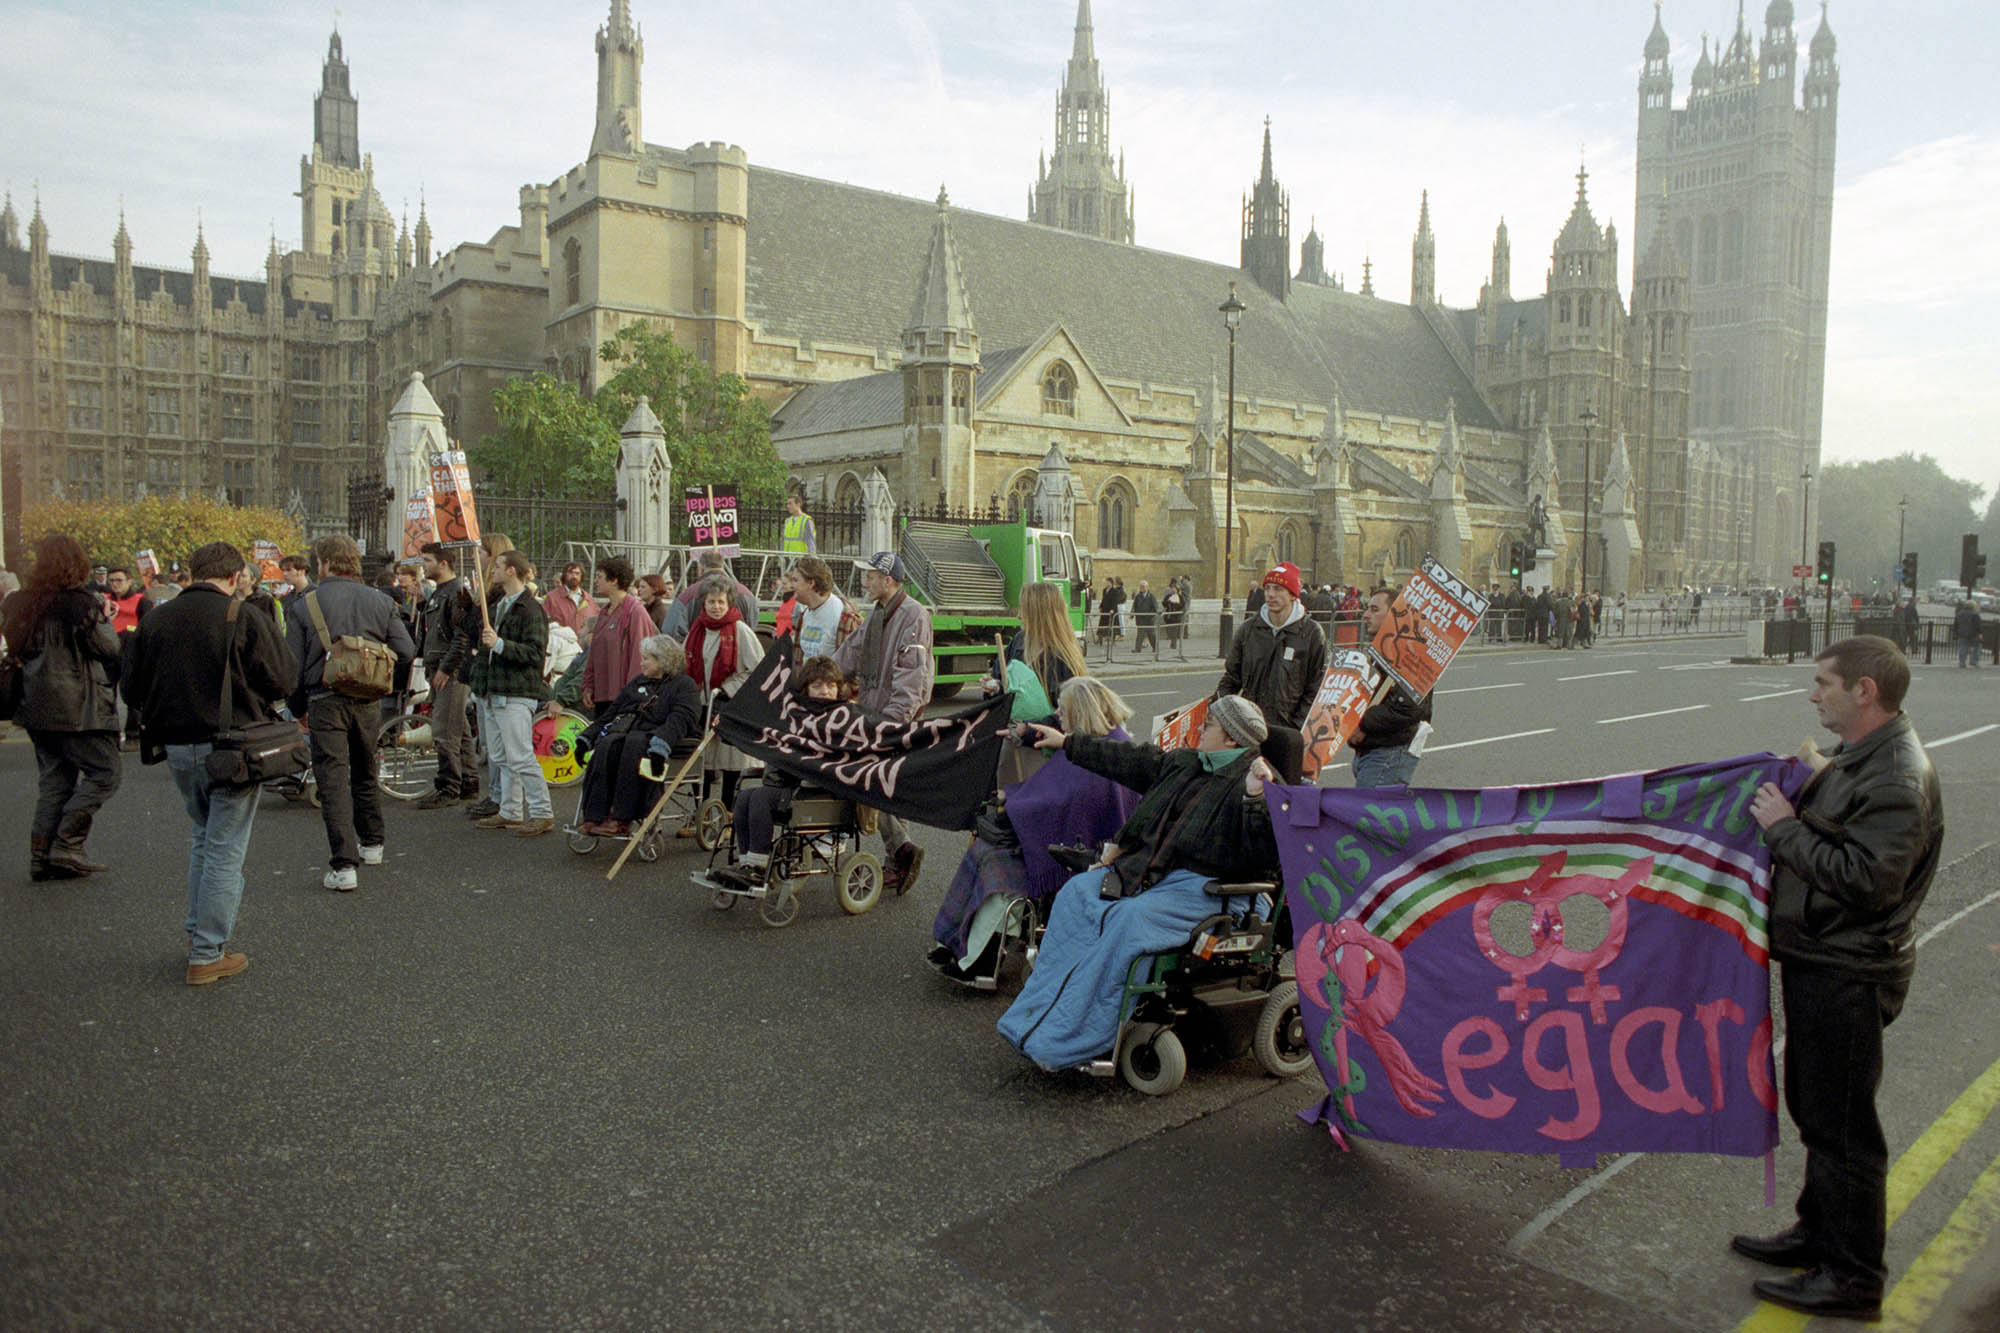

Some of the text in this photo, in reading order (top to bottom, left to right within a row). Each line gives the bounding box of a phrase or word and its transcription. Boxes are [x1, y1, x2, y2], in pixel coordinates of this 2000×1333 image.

[688, 510, 711, 527] pay
[695, 526, 734, 542] end
[1403, 586, 1425, 612] THE
[1421, 606, 1452, 633] ACT!
[1410, 575, 1457, 619] CAUGHT
[1455, 614, 1473, 633] IN
[1430, 563, 1486, 613] DAN
